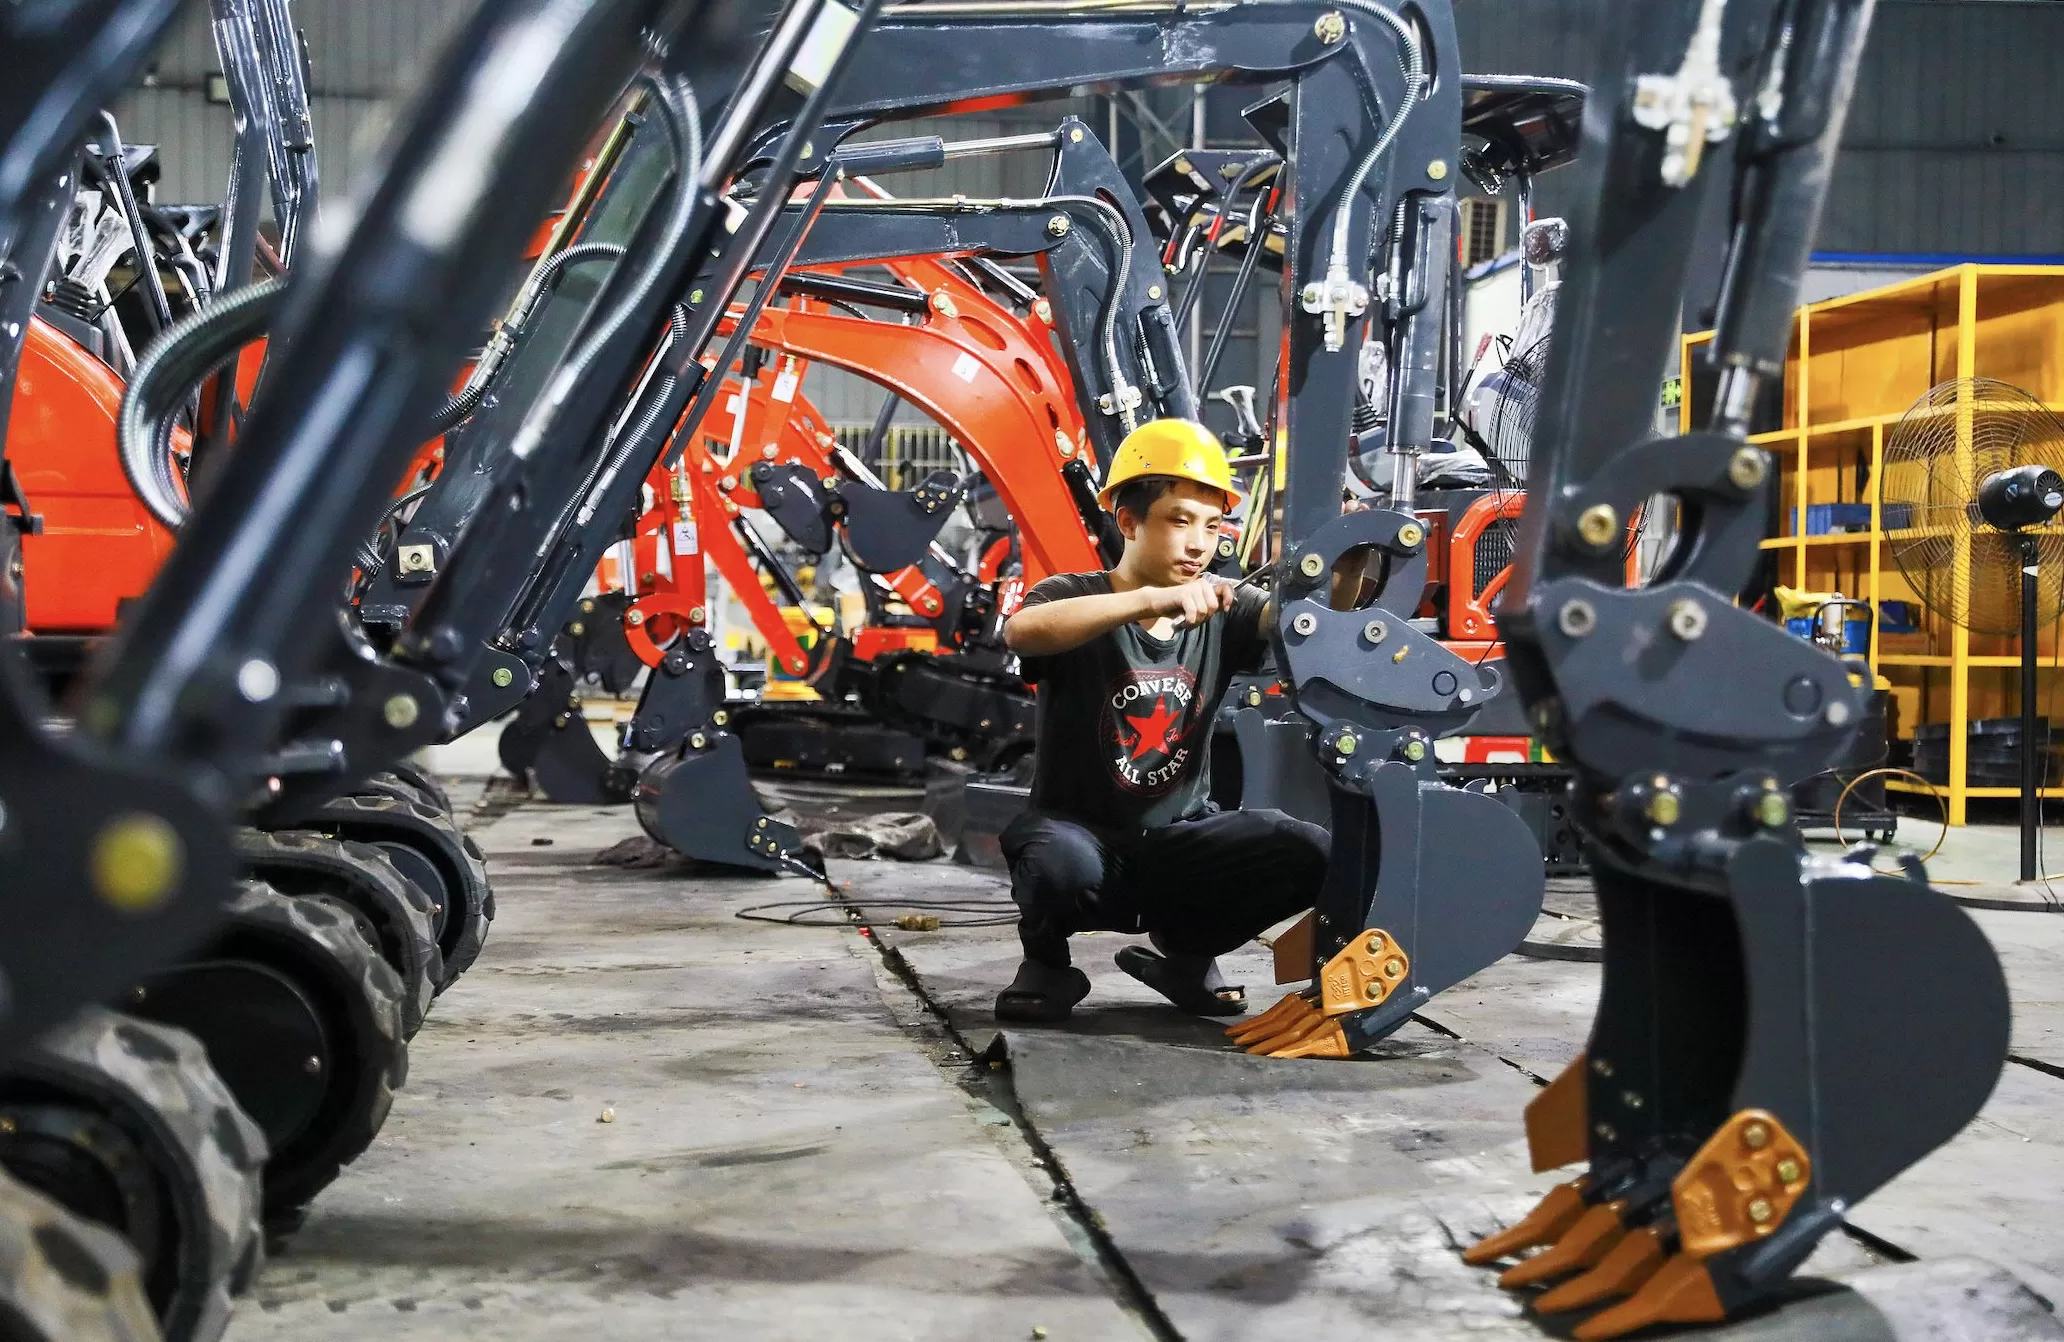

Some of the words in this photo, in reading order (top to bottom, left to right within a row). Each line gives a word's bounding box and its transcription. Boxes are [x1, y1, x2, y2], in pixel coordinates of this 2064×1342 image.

[1112, 677, 1192, 709] CONVESE
[1115, 755, 1140, 785] ALL
[1147, 748, 1188, 786] STAR
